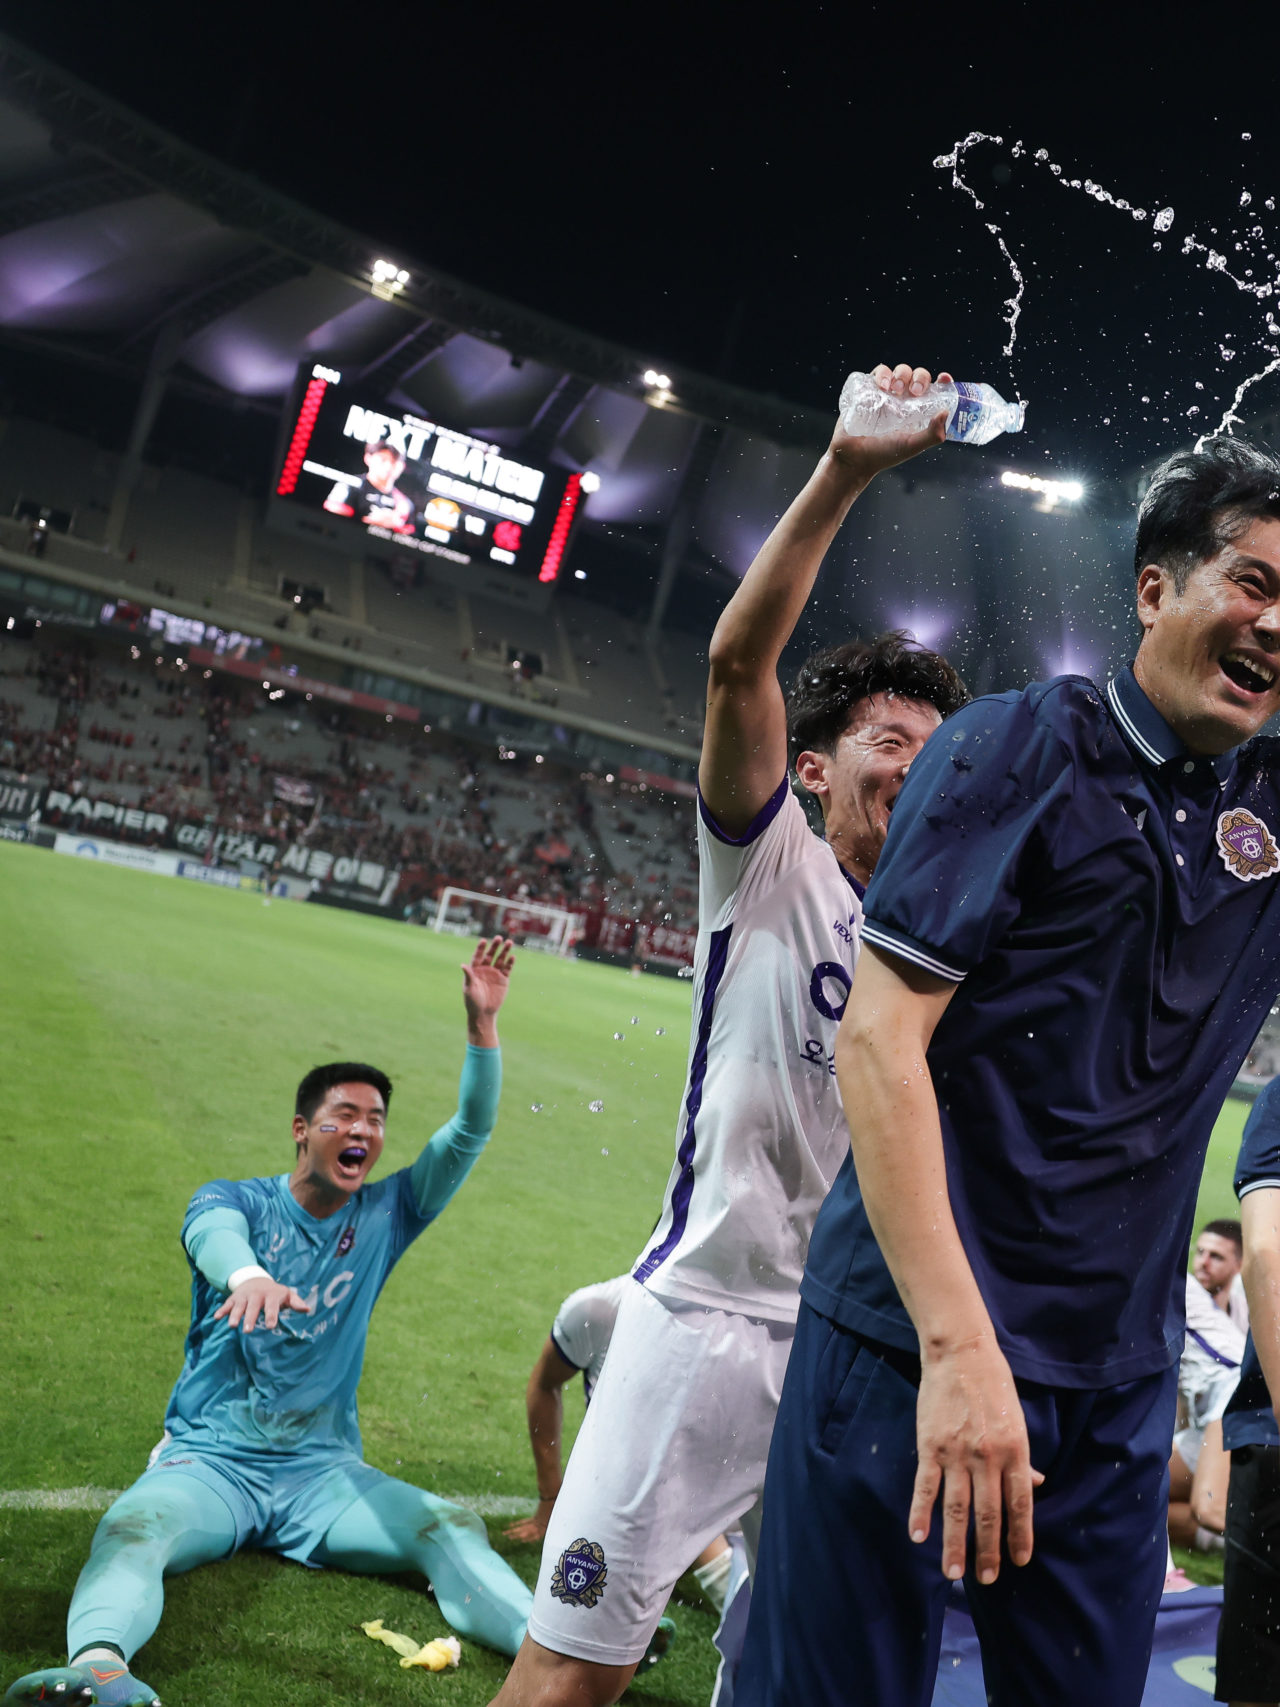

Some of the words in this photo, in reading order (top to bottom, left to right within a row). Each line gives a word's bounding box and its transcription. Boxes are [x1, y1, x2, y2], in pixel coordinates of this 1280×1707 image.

[343, 405, 431, 460] NEXT
[431, 436, 545, 502] MATCH
[46, 790, 168, 835] RAPIER
[1229, 827, 1259, 841] ANYANG
[566, 1555, 600, 1571] ANYANG
